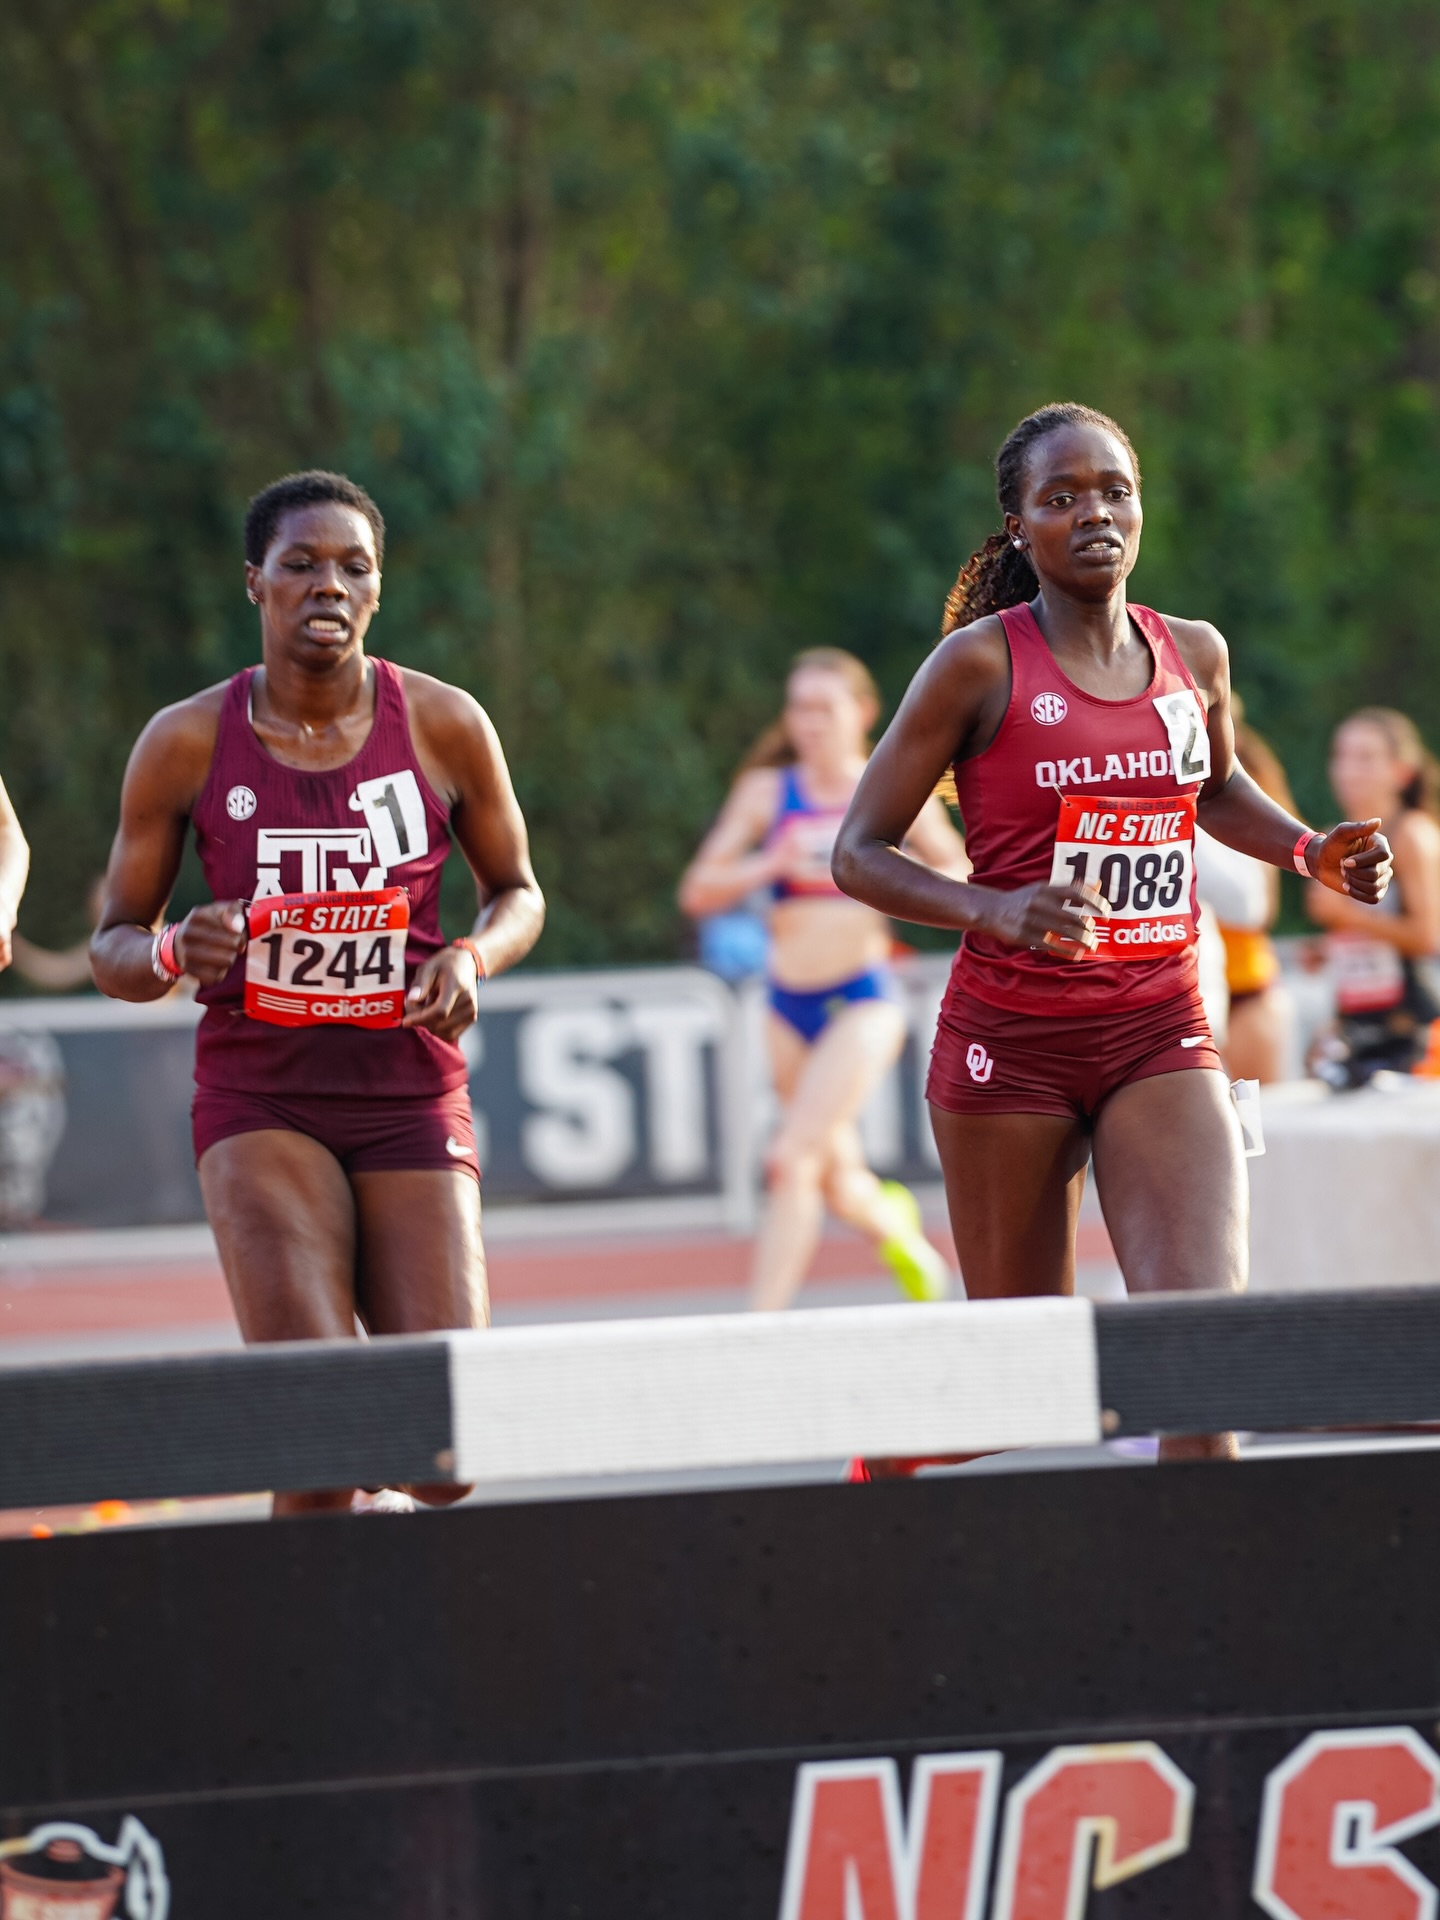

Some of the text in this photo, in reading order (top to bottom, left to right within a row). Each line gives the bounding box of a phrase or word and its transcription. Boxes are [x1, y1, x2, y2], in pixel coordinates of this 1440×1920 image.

[1033, 694, 1066, 724] SEC
[1167, 699, 1205, 776] 2
[372, 782, 410, 856] 1
[1075, 811, 1186, 842] NC STATE
[1062, 850, 1185, 912] 1083
[270, 903, 393, 931] NC STATE
[1113, 920, 1188, 944] adidas
[261, 933, 394, 989] 1244
[310, 997, 394, 1018] adidas
[966, 1042, 994, 1083] OU
[779, 1740, 1195, 1920] NC
